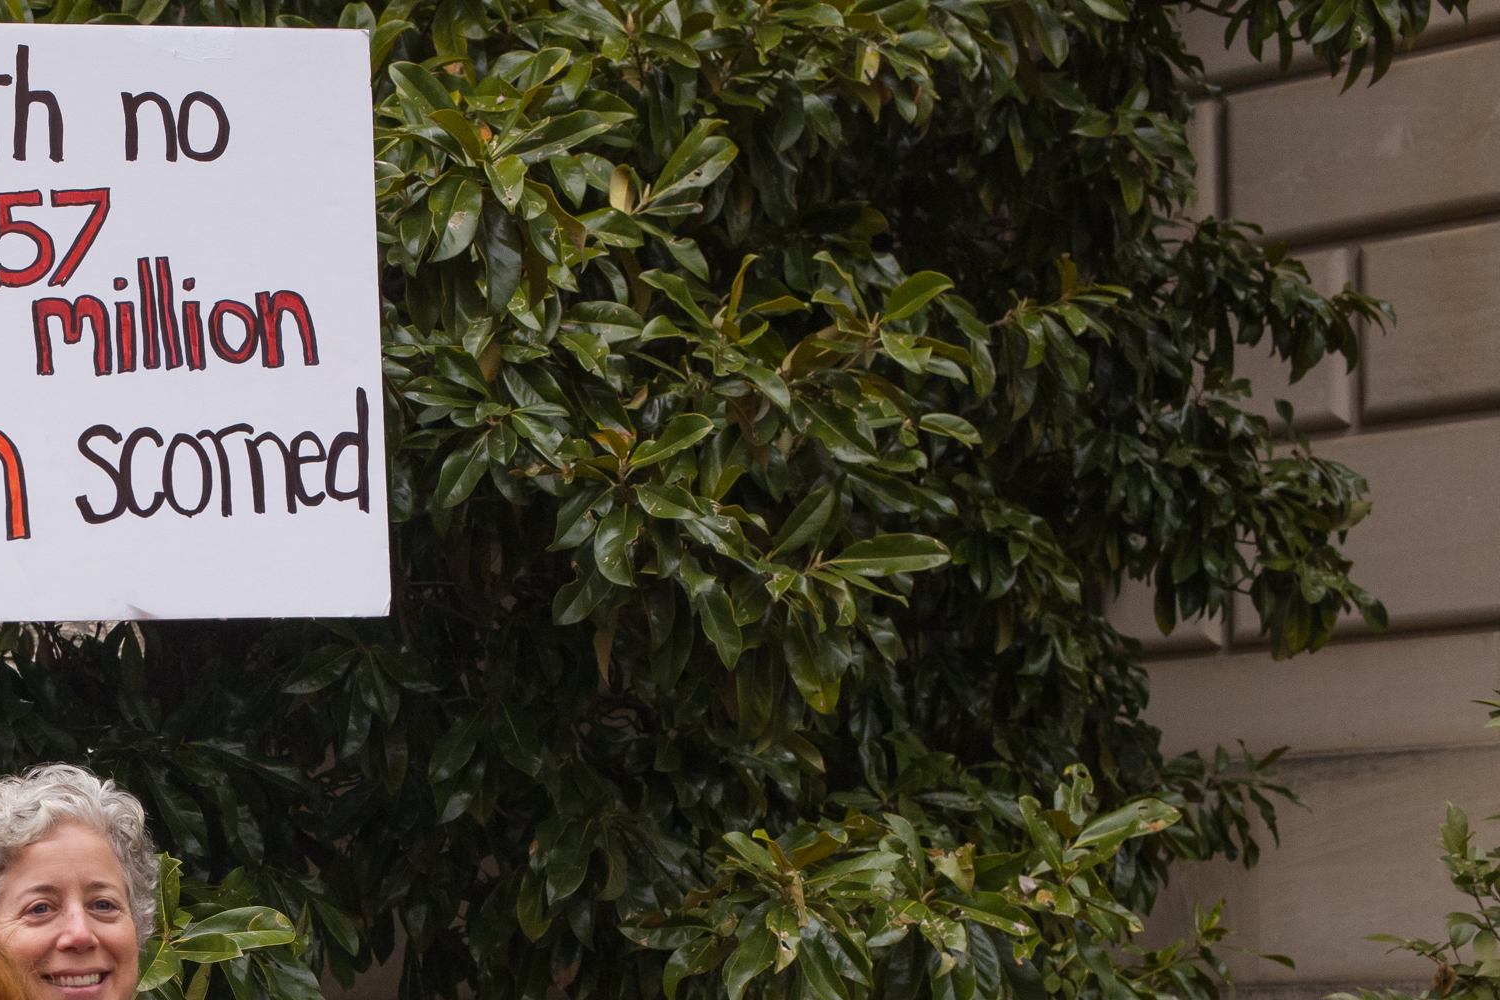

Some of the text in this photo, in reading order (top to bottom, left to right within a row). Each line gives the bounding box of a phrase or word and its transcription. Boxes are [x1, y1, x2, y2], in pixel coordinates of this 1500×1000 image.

[121, 91, 231, 163] no
[31, 256, 320, 376] million
[75, 386, 370, 526] scorned
